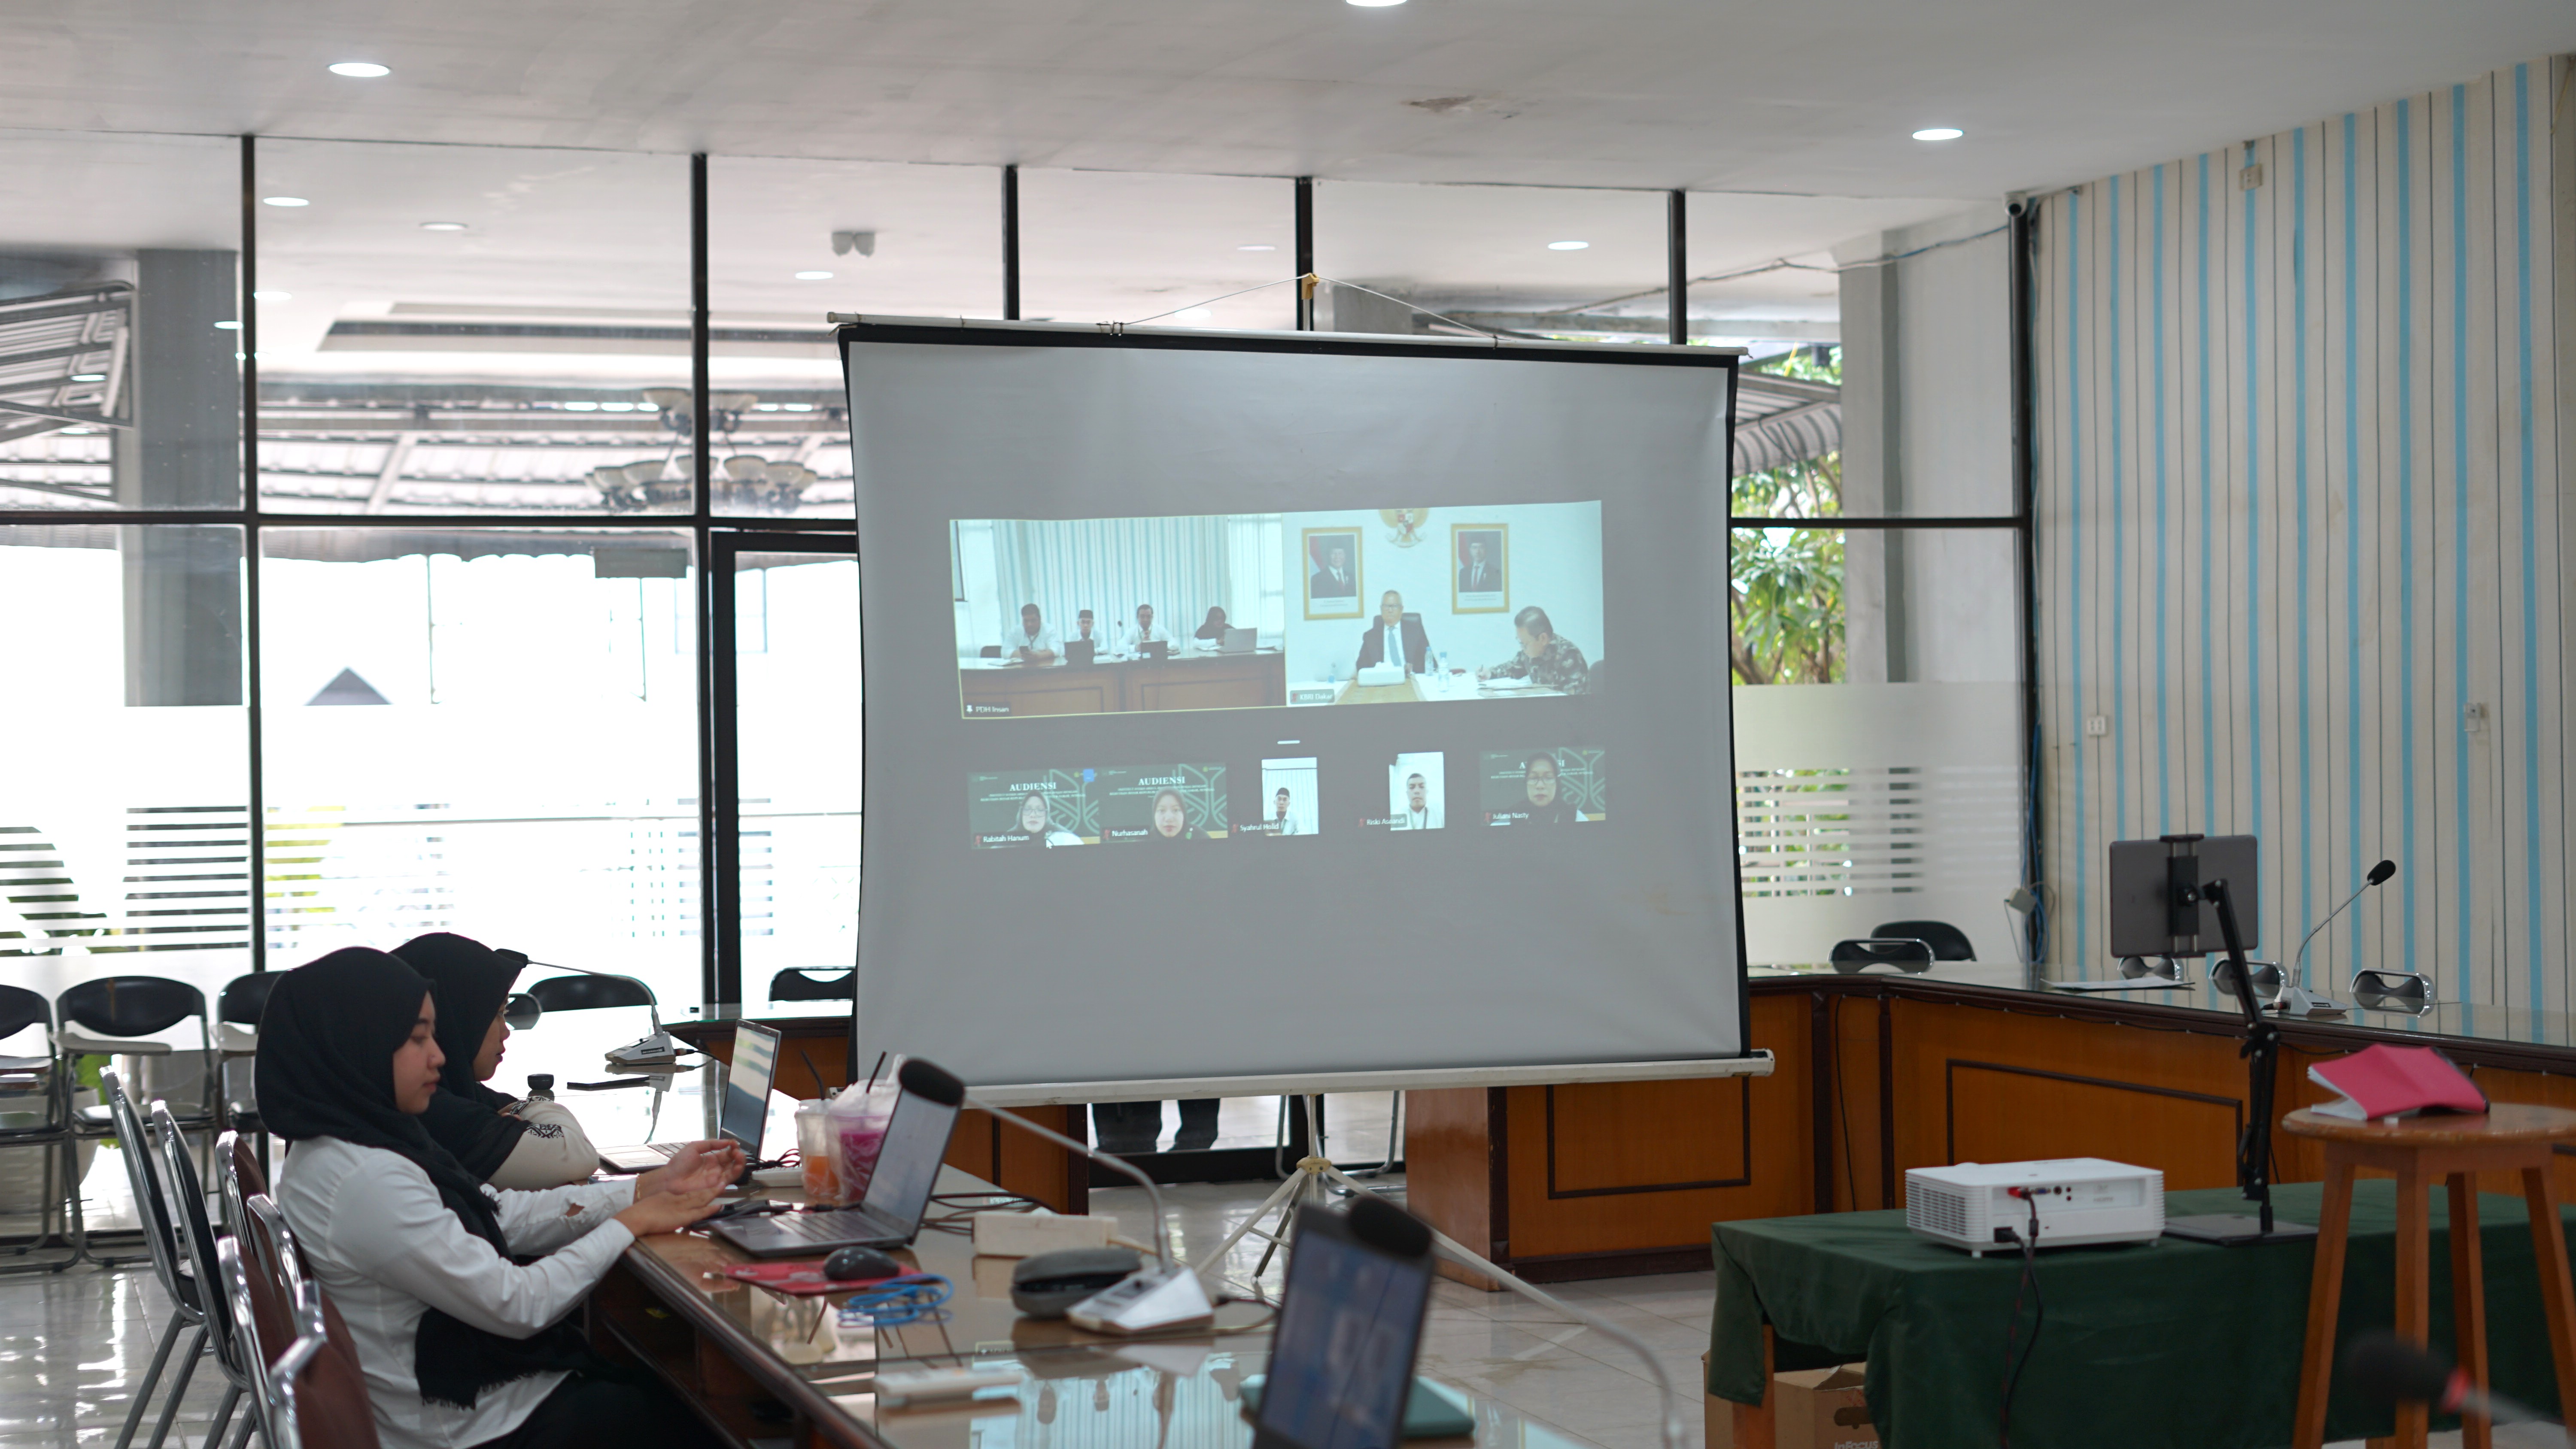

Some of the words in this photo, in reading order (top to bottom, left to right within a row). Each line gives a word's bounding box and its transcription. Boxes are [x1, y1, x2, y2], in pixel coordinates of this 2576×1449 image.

[1138, 776, 1185, 785] AUDIENSI
[1009, 782, 1057, 791] AUDIENSI
[1112, 828, 1148, 837] Nurhasanah
[1240, 824, 1262, 832] Syahrul
